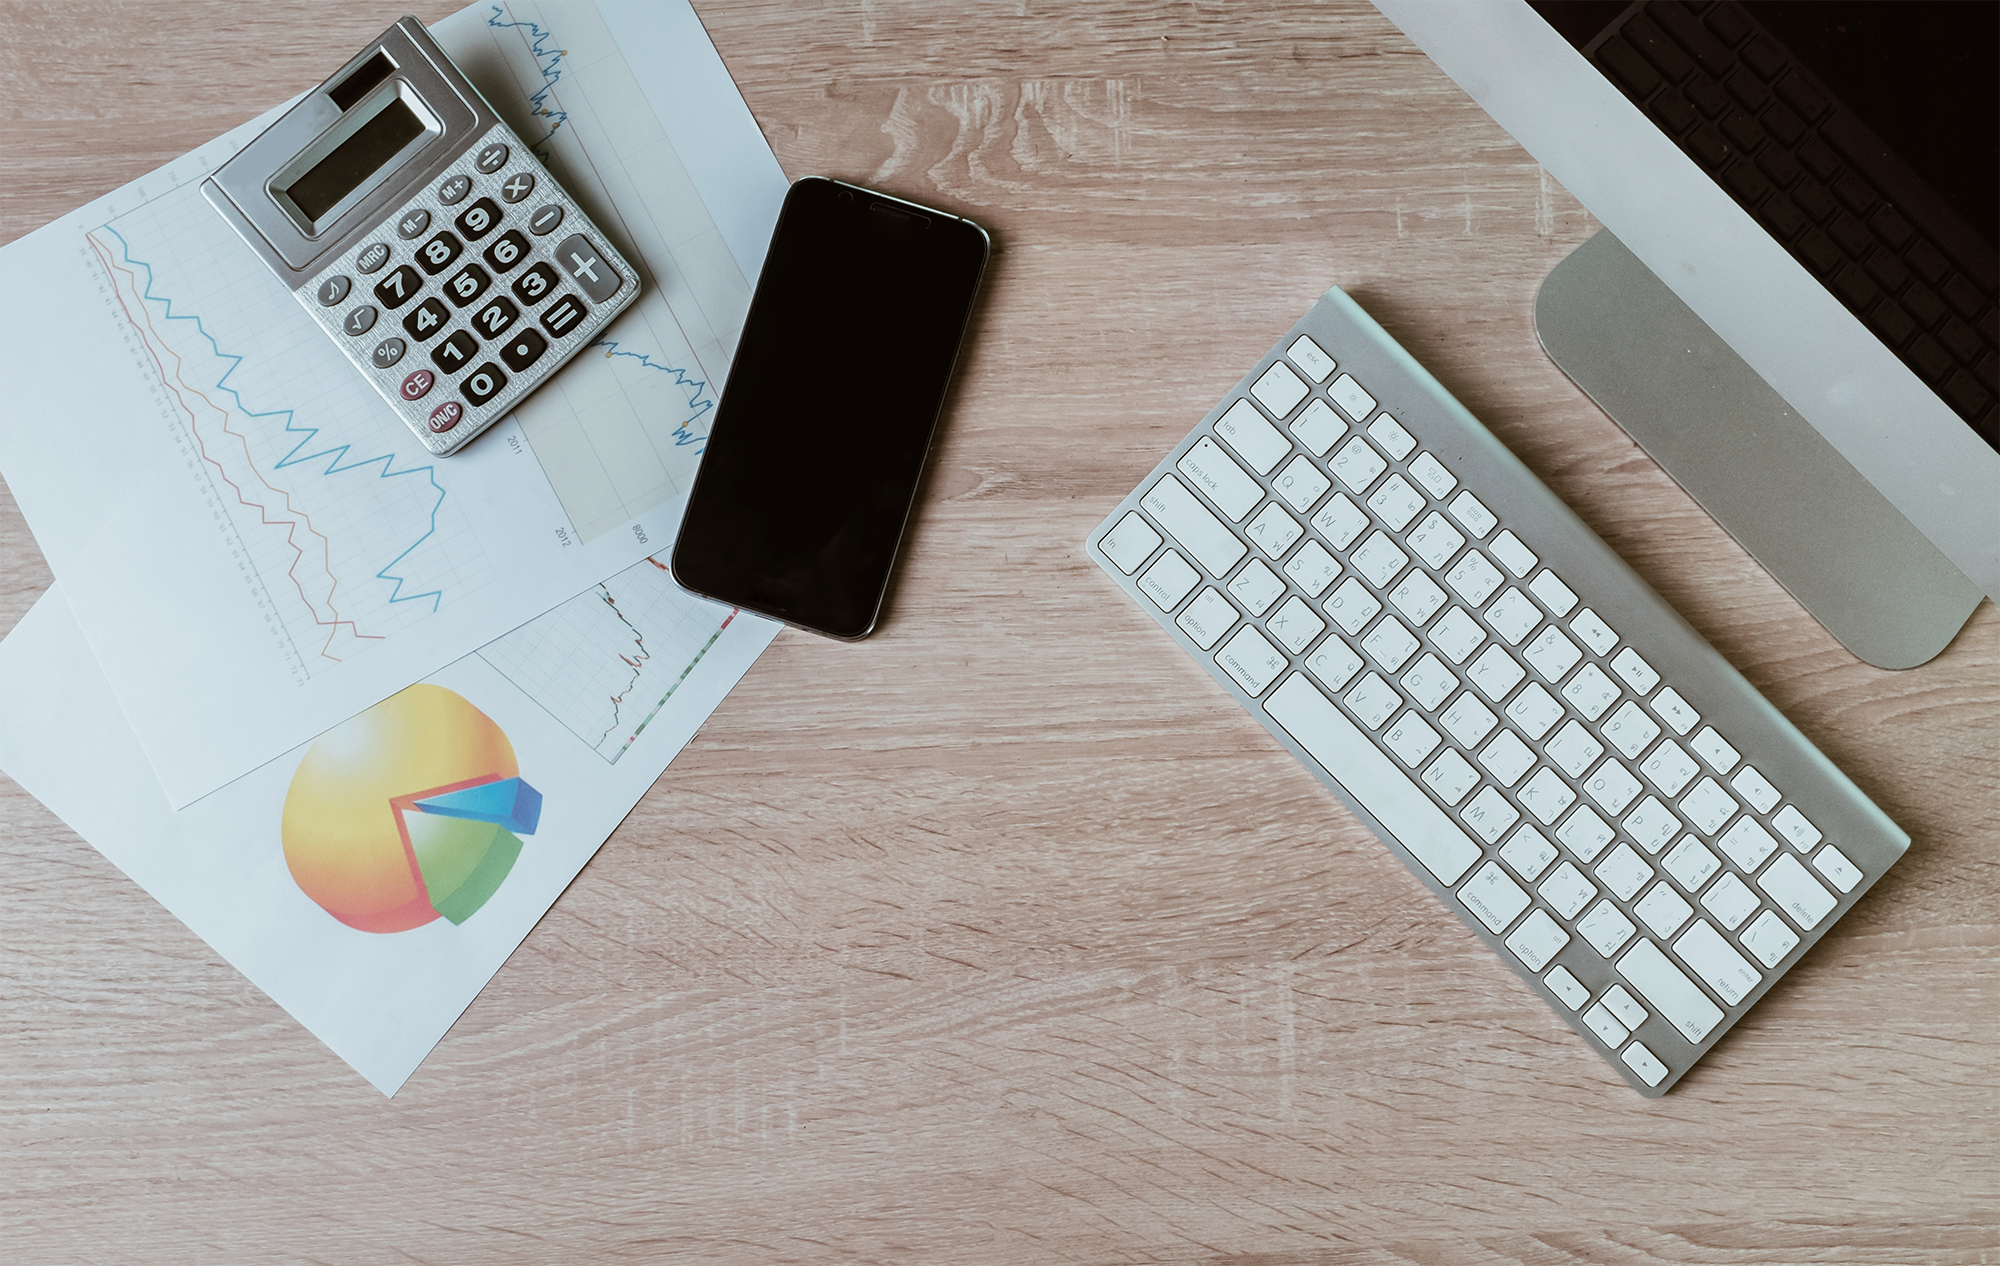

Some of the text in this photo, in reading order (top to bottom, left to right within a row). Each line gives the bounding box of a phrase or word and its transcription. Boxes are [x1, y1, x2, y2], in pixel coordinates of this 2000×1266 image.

[442, 180, 463, 200] M+
[402, 214, 424, 235] M-
[466, 208, 490, 231] 9
[359, 245, 385, 270] MRC
[426, 240, 451, 264] 8
[495, 241, 518, 263] 6
[382, 272, 406, 297] 7
[454, 274, 478, 296] 5
[522, 272, 547, 295] 3
[416, 309, 437, 331] 4
[482, 307, 508, 331] 2
[379, 344, 398, 361] %
[443, 342, 464, 361] 1
[1306, 351, 1320, 365] esc
[405, 374, 428, 396] CE
[470, 373, 493, 396] 0
[429, 404, 457, 428] ON/C
[1222, 420, 1236, 435] tab
[507, 435, 522, 454] 2011
[1336, 456, 1349, 469] 2
[1185, 458, 1218, 491] caps lock
[1281, 475, 1295, 490] Q
[1148, 496, 1167, 513] shift
[1375, 493, 1388, 506] 3
[1320, 510, 1337, 528] W
[632, 524, 648, 544] 8000
[1252, 522, 1266, 536] A
[556, 527, 572, 548] 2012
[1106, 537, 1116, 549] fn
[1415, 533, 1427, 543] 4
[1357, 548, 1370, 561] E
[1291, 558, 1305, 571] S
[1453, 569, 1466, 581] 5
[1144, 576, 1171, 602] control
[1235, 576, 1250, 591] Z
[1204, 594, 1214, 604] alt
[1396, 586, 1410, 600] R
[1330, 595, 1344, 609] D
[1493, 608, 1504, 619] 6
[1184, 614, 1207, 638] option
[1274, 614, 1289, 630] X
[1438, 624, 1450, 636] T
[1369, 633, 1383, 644] F
[1532, 644, 1545, 655] 7
[1314, 653, 1328, 667] C
[1224, 654, 1261, 689] command
[1477, 662, 1489, 675] Y
[1409, 673, 1423, 687] G
[1354, 690, 1367, 703] V
[1571, 683, 1583, 695] 8
[1514, 700, 1529, 715] U
[1446, 710, 1462, 725] H
[1610, 721, 1622, 732] 9
[1390, 728, 1403, 742] B
[1486, 750, 1499, 760] J
[1428, 766, 1445, 782] N
[1592, 778, 1606, 791] O
[1524, 786, 1540, 801] K
[1468, 805, 1486, 822] M
[1630, 814, 1644, 825] P
[1564, 824, 1574, 838] L
[1466, 891, 1503, 926] command
[1791, 901, 1814, 924] delete
[1552, 935, 1562, 944] alt
[1518, 943, 1542, 966] option
[1738, 967, 1754, 983] enter
[1716, 977, 1739, 1000] return
[1684, 1020, 1702, 1037] shift
